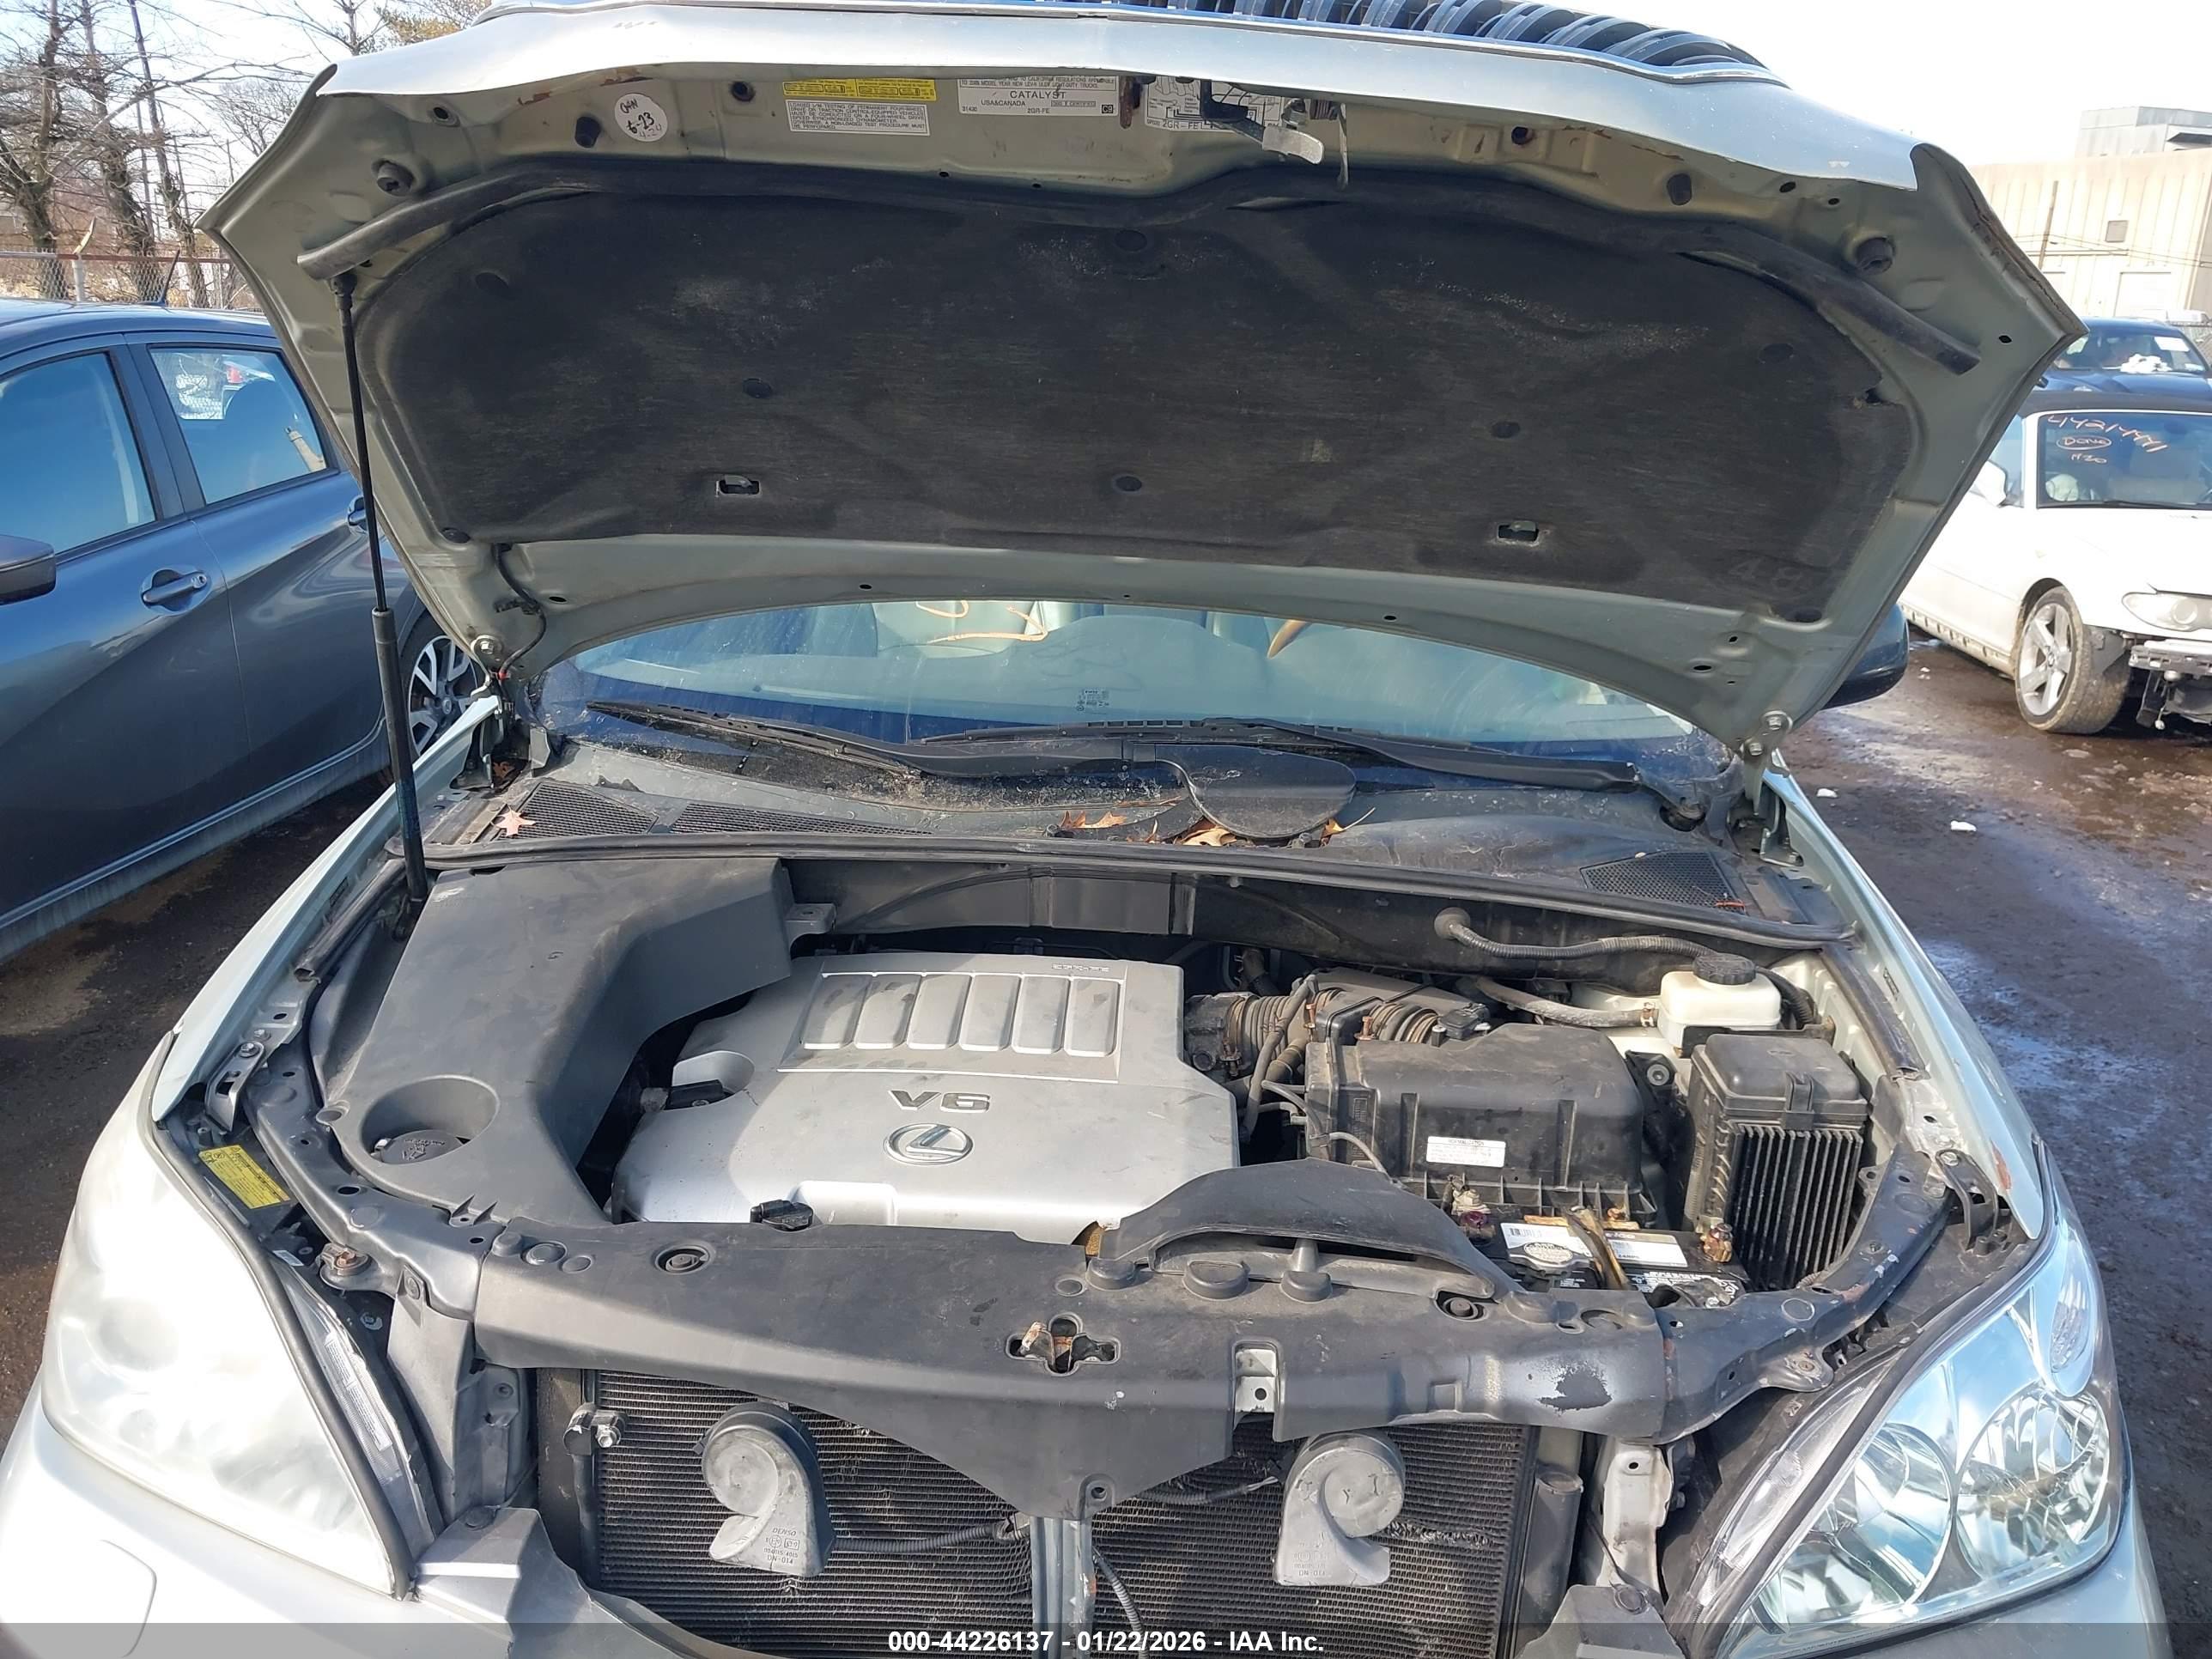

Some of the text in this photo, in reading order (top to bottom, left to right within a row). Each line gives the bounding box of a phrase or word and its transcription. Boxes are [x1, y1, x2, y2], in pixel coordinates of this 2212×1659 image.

[1010, 90, 1066, 100] CATALYST
[888, 1089, 991, 1114] V6
[772, 1527, 797, 1537] DENSO
